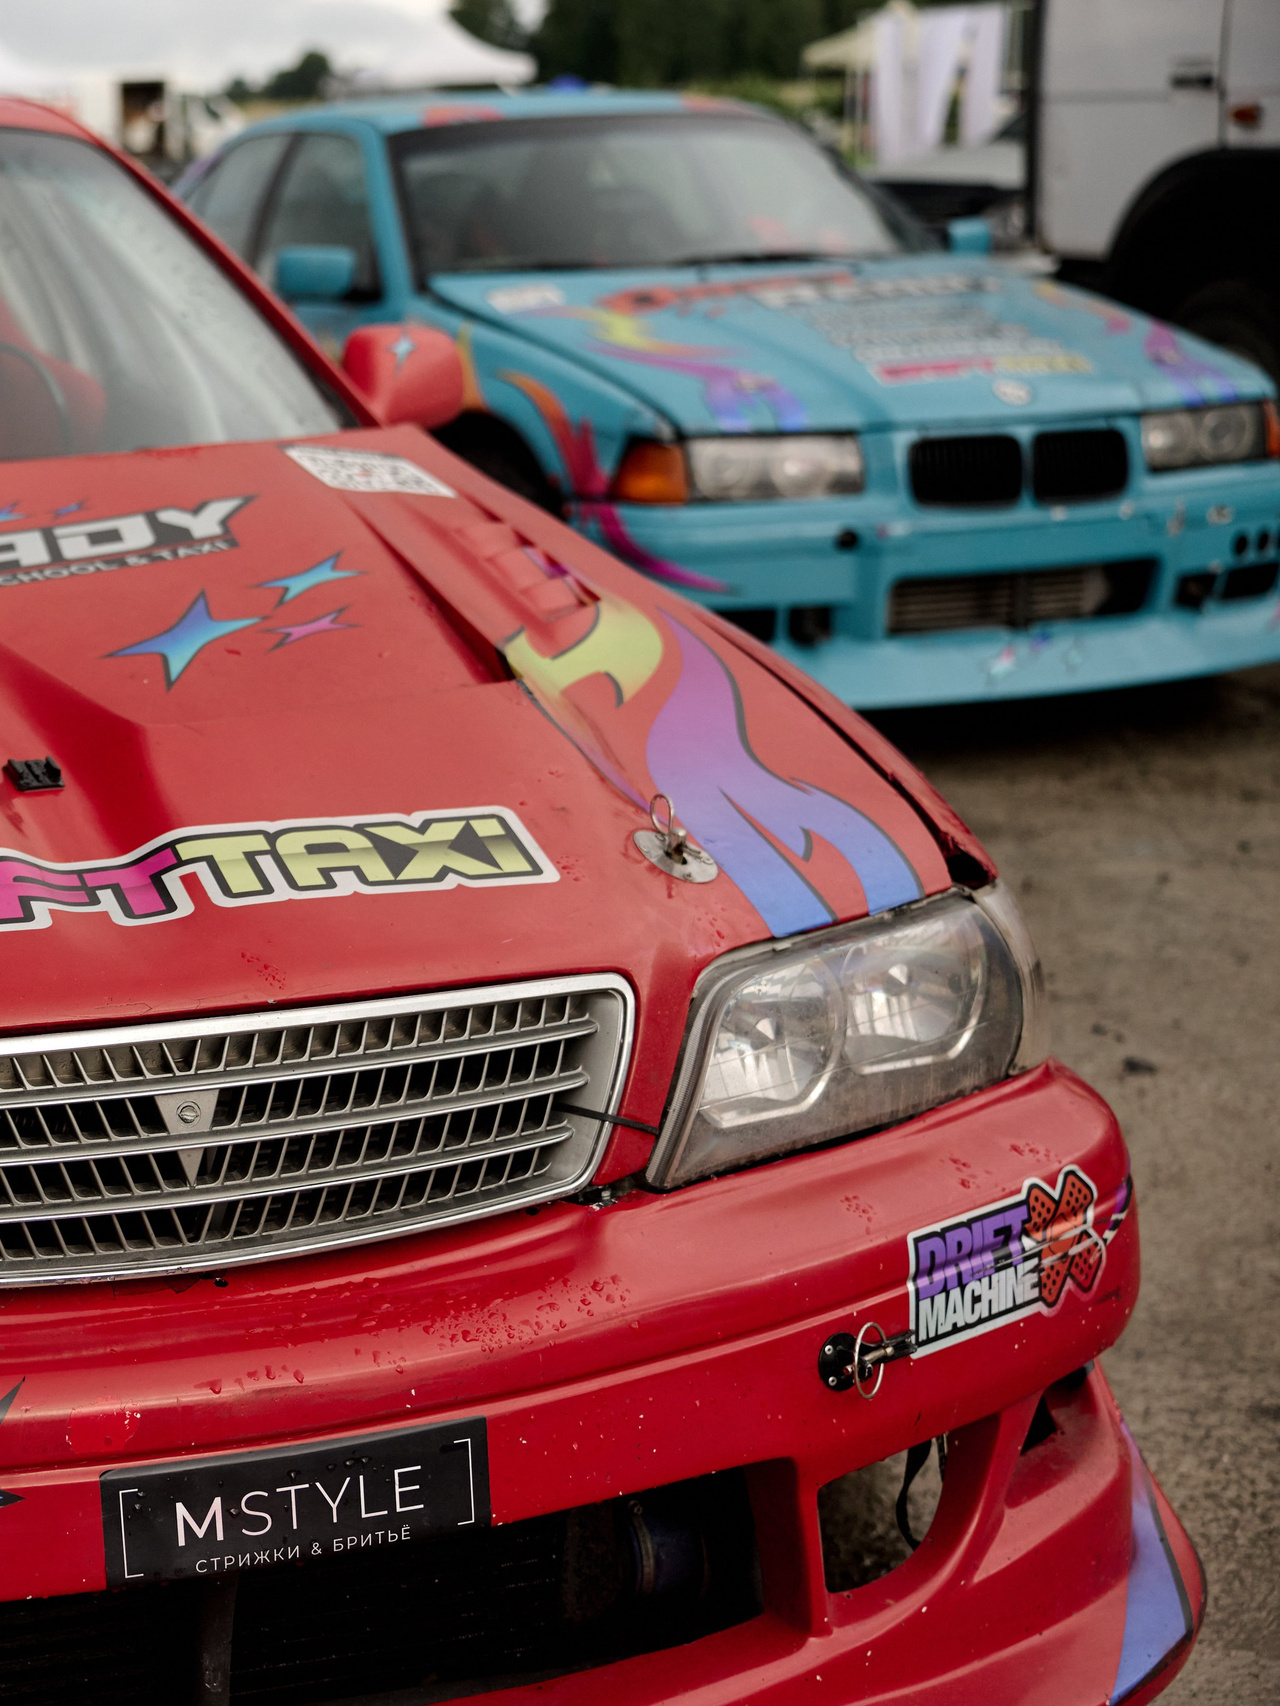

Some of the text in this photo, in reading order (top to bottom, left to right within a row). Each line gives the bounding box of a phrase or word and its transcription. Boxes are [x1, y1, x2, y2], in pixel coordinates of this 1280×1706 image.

[153, 539, 231, 560] TAXI
[916, 1203, 1030, 1300] DRIFT
[919, 1256, 1040, 1342] MACHINE
[195, 1523, 412, 1573] СТРИЖКИ & БРИТЬЁ
